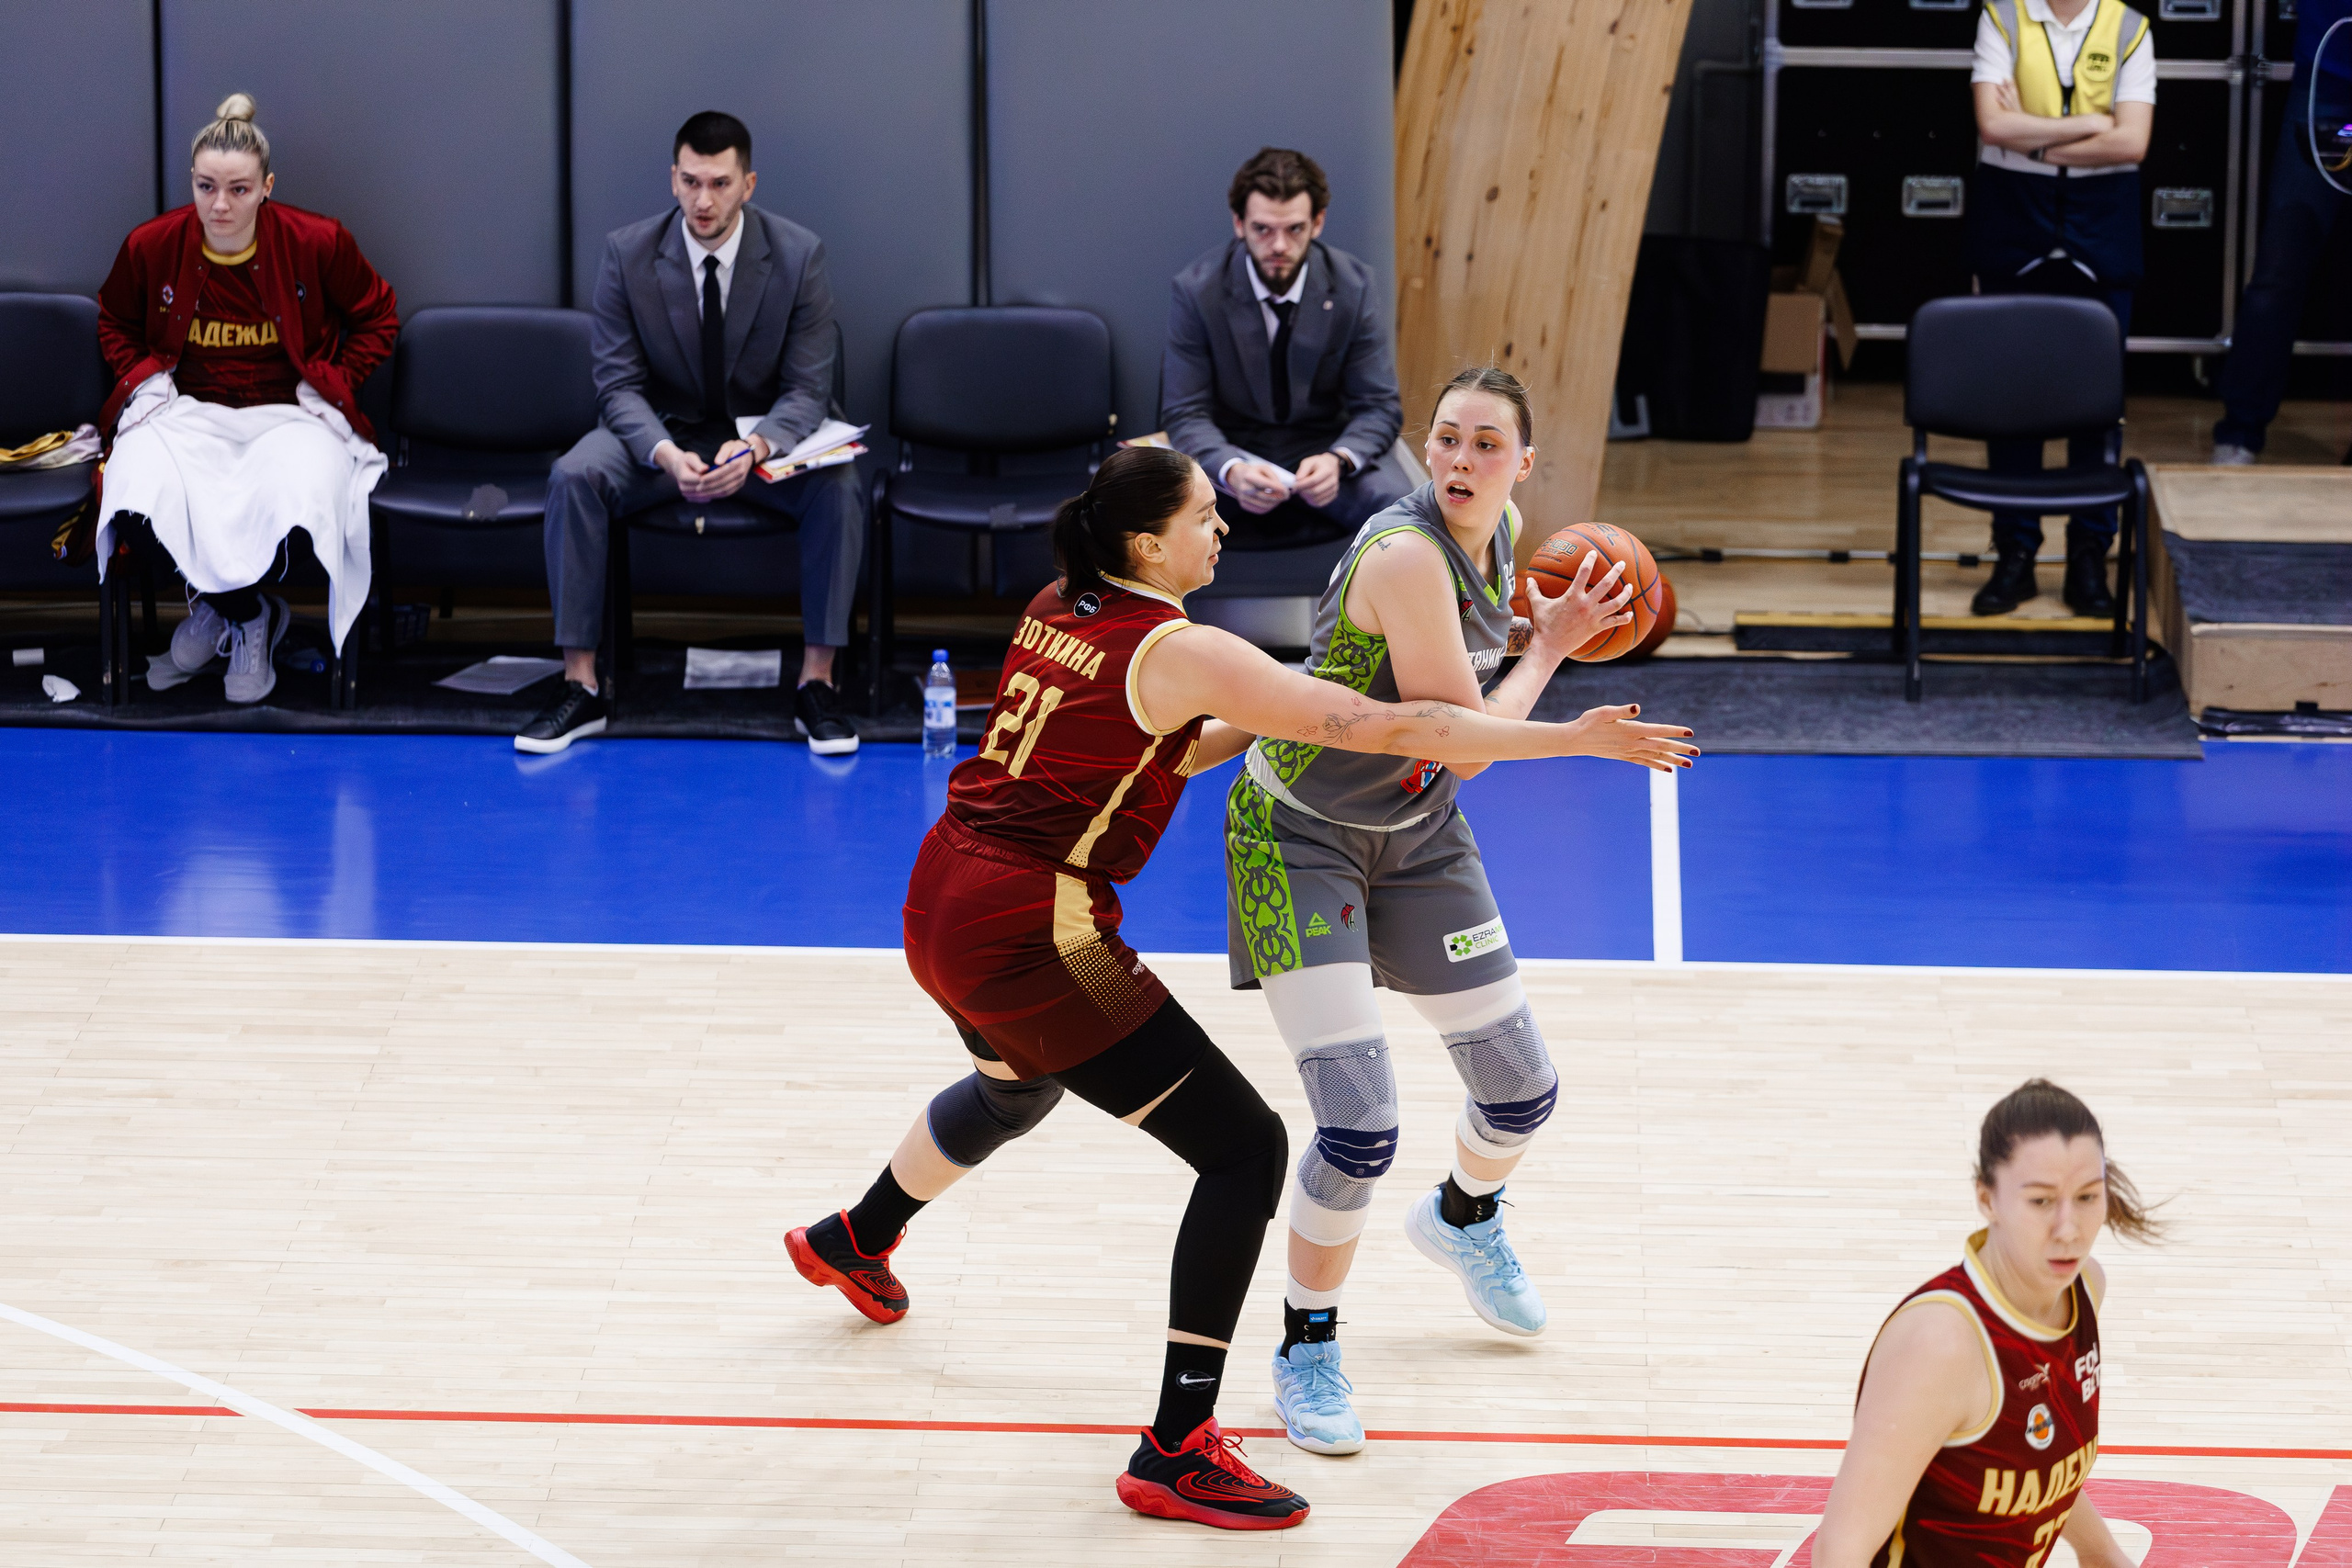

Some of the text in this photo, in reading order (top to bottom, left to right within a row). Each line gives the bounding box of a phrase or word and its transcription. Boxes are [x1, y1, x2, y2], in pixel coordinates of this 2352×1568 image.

[187, 317, 278, 347] АДЕЖД
[1079, 600, 1097, 614] РФБ
[979, 671, 1065, 779] 21
[1306, 925, 1332, 938] PEAK
[1476, 934, 1499, 949] CLINIC
